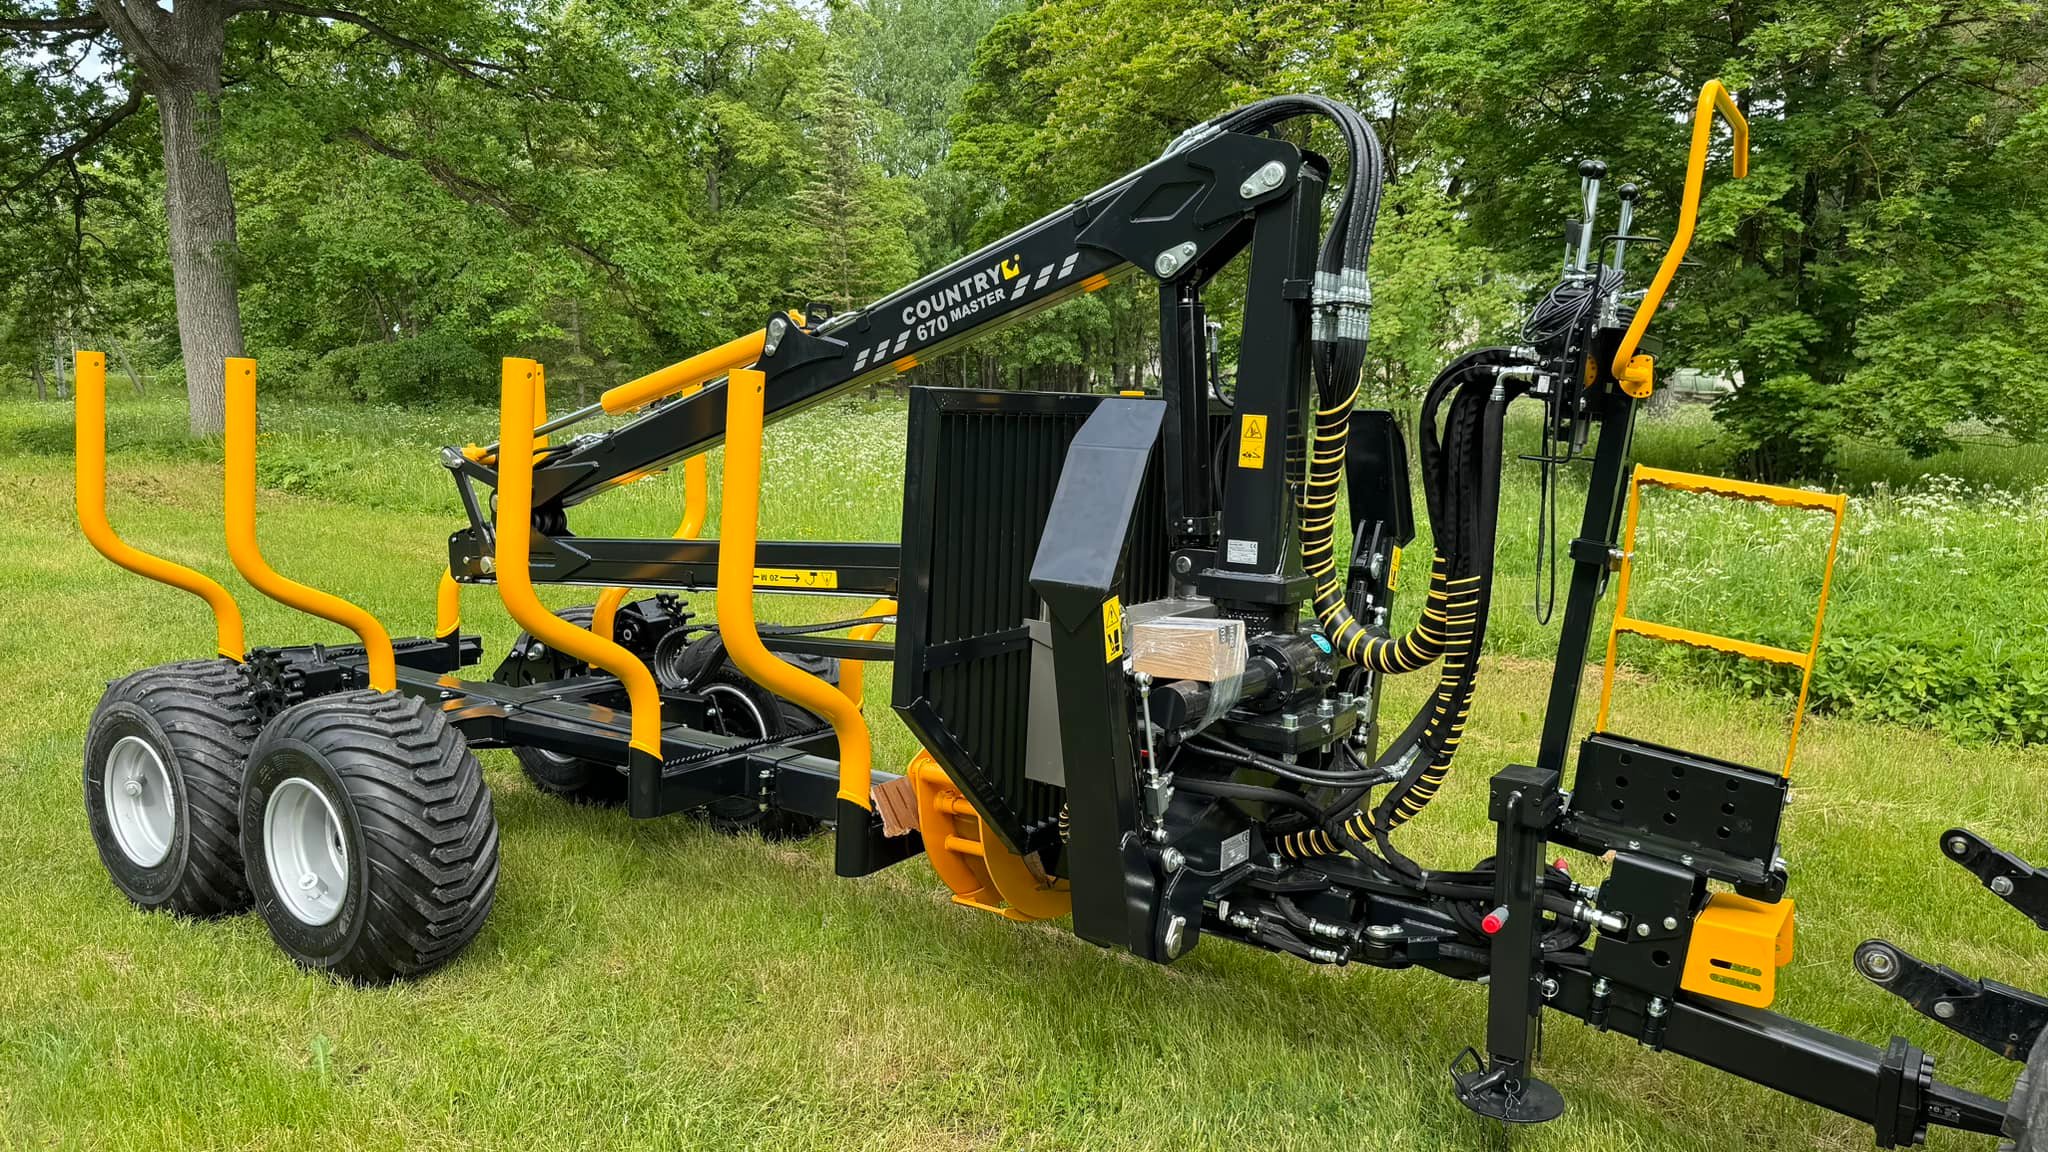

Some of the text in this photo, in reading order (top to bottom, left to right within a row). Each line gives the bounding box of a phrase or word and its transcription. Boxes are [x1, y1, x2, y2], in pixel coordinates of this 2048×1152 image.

[902, 264, 1000, 325] COUNTRY
[916, 287, 1006, 341] 670 MASTER
